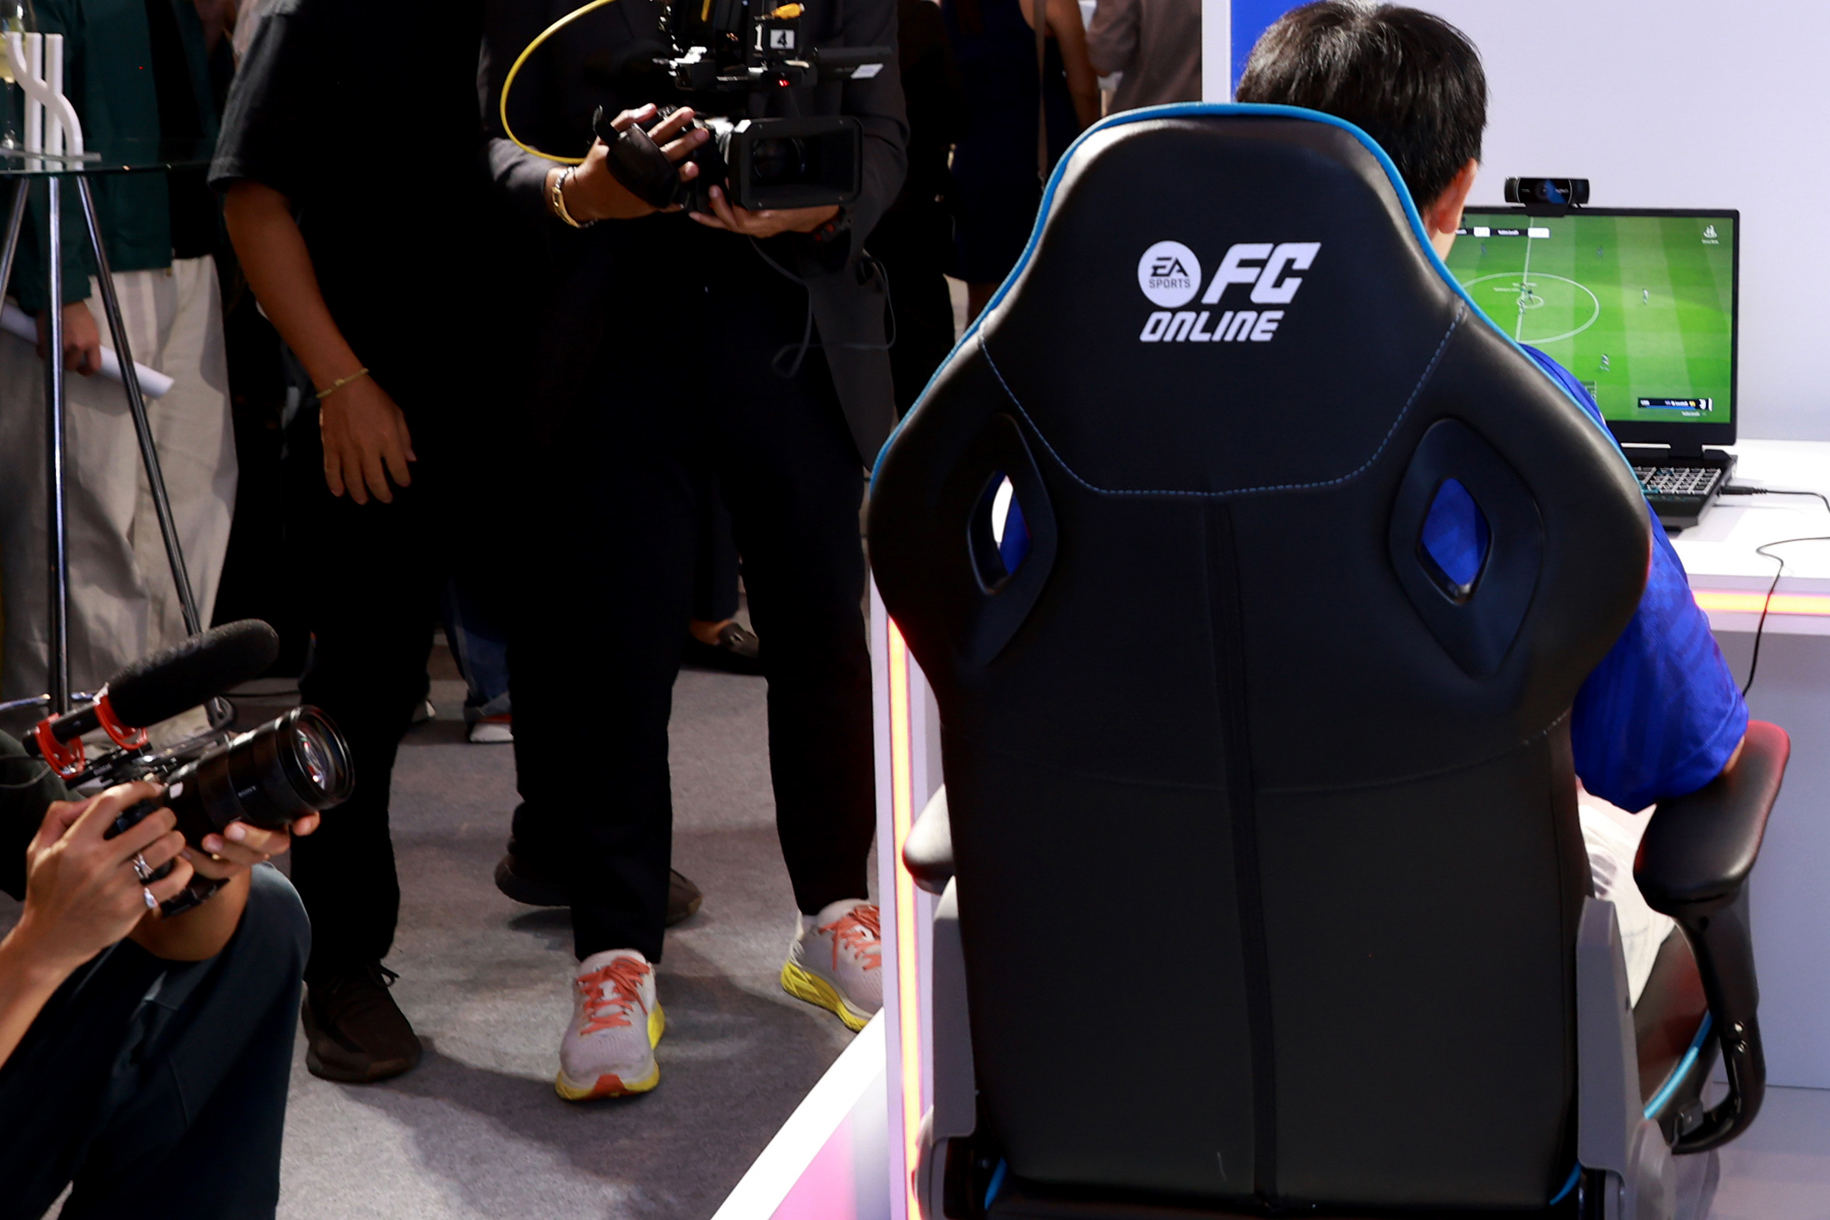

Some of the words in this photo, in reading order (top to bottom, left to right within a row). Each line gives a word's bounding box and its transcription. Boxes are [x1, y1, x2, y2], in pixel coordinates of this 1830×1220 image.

[1150, 257, 1189, 278] EA
[1200, 242, 1322, 305] FC
[1149, 278, 1191, 290] SPORTS
[1139, 310, 1285, 342] ONLINE
